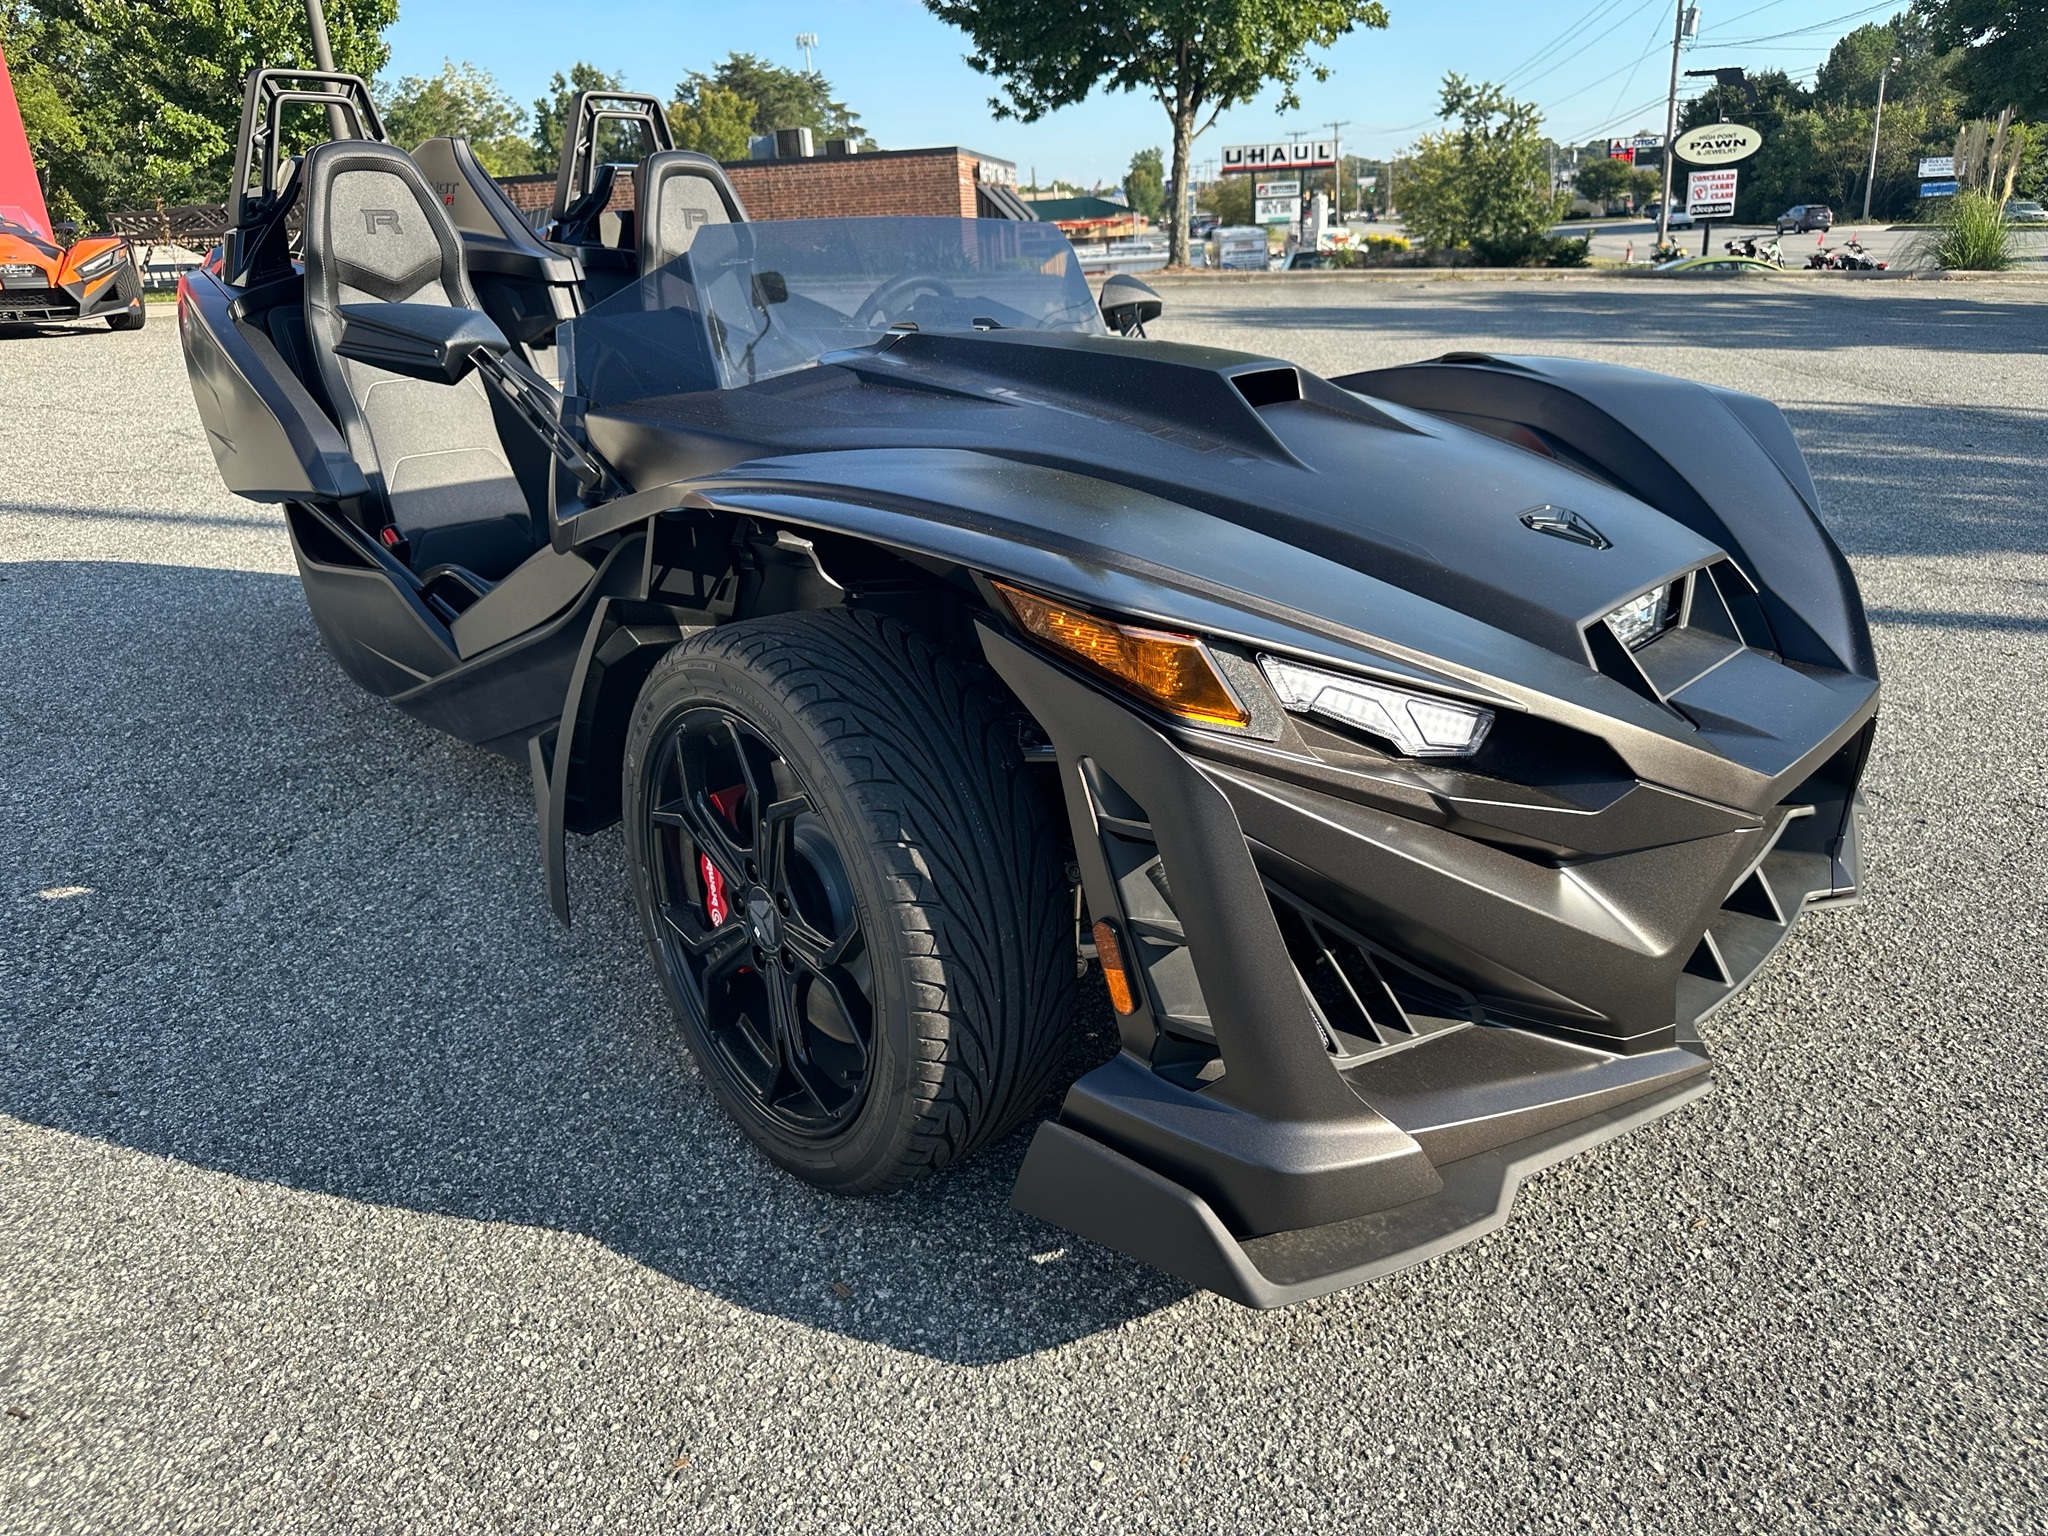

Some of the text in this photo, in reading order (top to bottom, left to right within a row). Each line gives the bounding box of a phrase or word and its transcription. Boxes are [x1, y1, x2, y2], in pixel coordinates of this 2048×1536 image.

[1690, 139, 1746, 150] PAWN
[1692, 174, 1736, 183] CONCEALED
[1710, 183, 1735, 191] CARRY
[444, 194, 455, 205] R
[1710, 192, 1734, 200] CLASS
